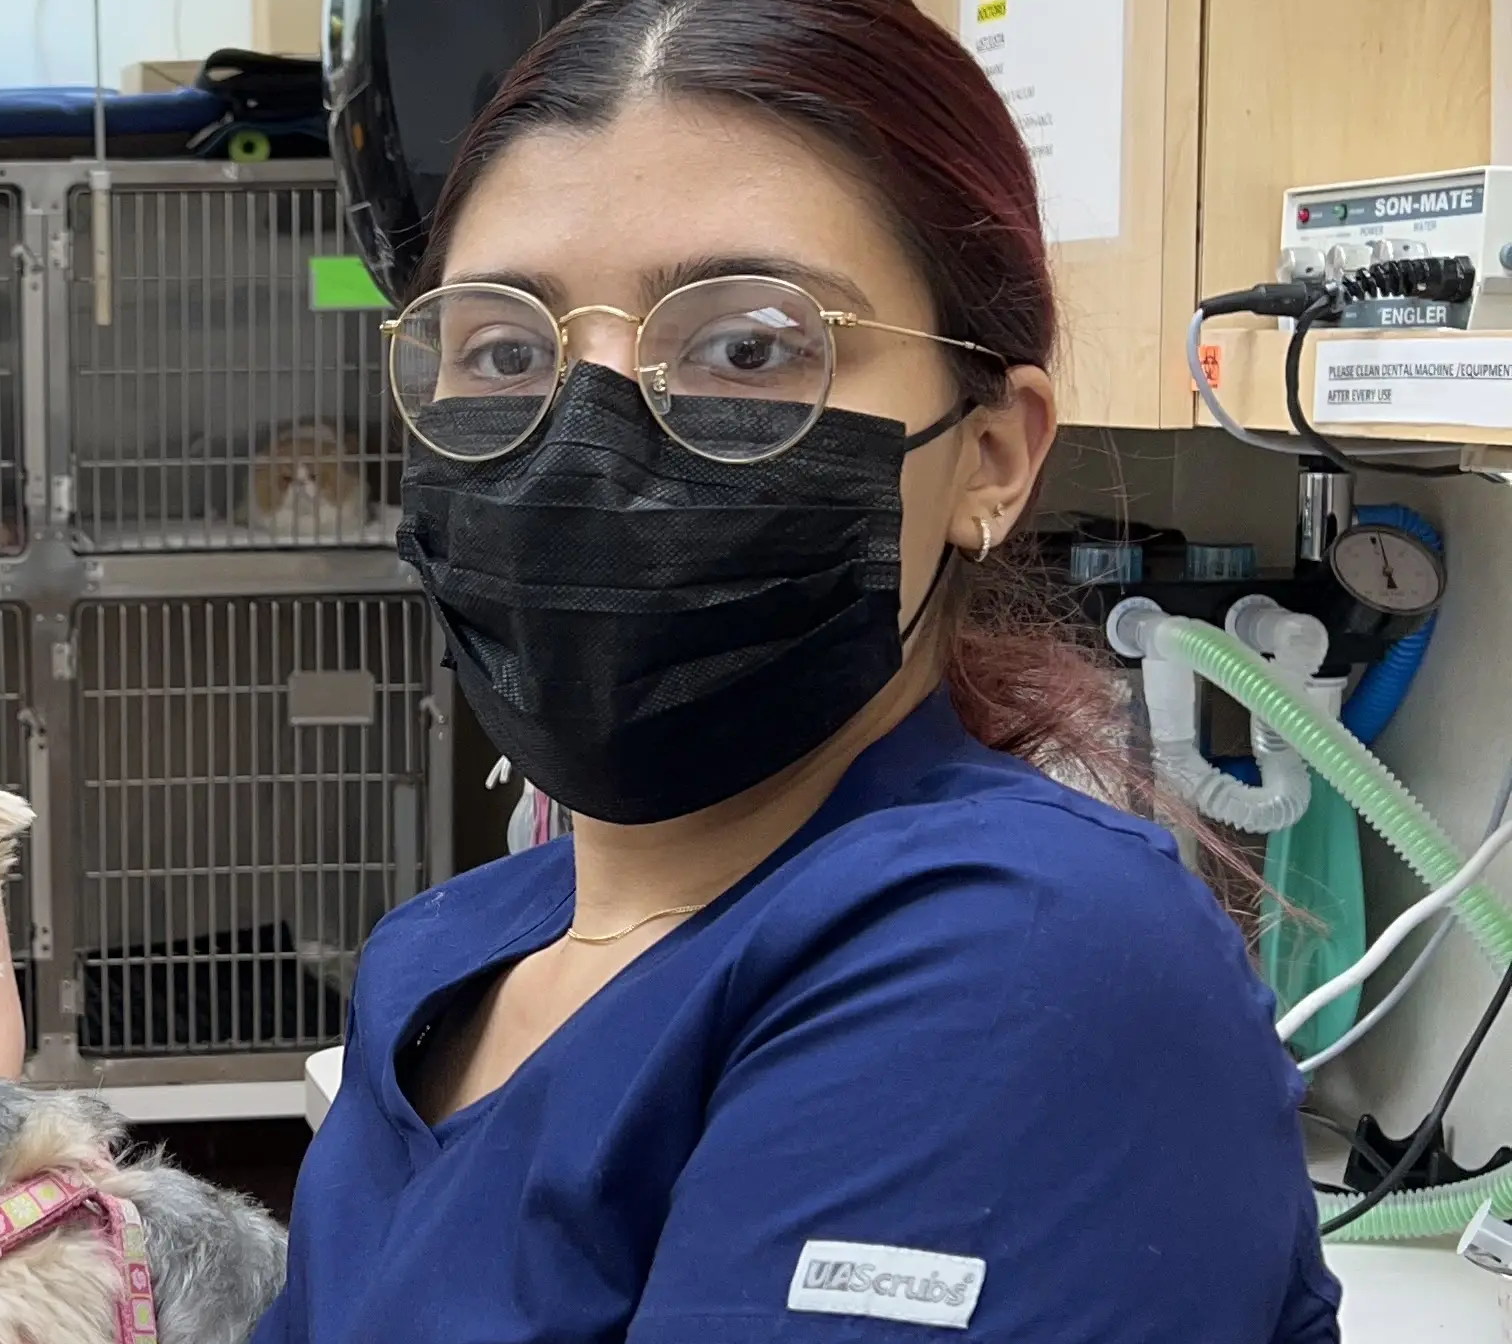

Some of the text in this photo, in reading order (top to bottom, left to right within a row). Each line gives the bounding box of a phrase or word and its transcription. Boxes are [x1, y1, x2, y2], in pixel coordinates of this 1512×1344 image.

[1374, 190, 1473, 217] SON-MATE
[1360, 221, 1437, 236] POWER WATER
[1381, 306, 1447, 325] ENGLER
[1328, 365, 1354, 378] PLEASE
[1356, 365, 1380, 377] CLEAN
[1382, 364, 1413, 377] DENTAL
[1414, 364, 1454, 376] MACHINE
[1328, 388, 1392, 402] AFTER EVERY USE
